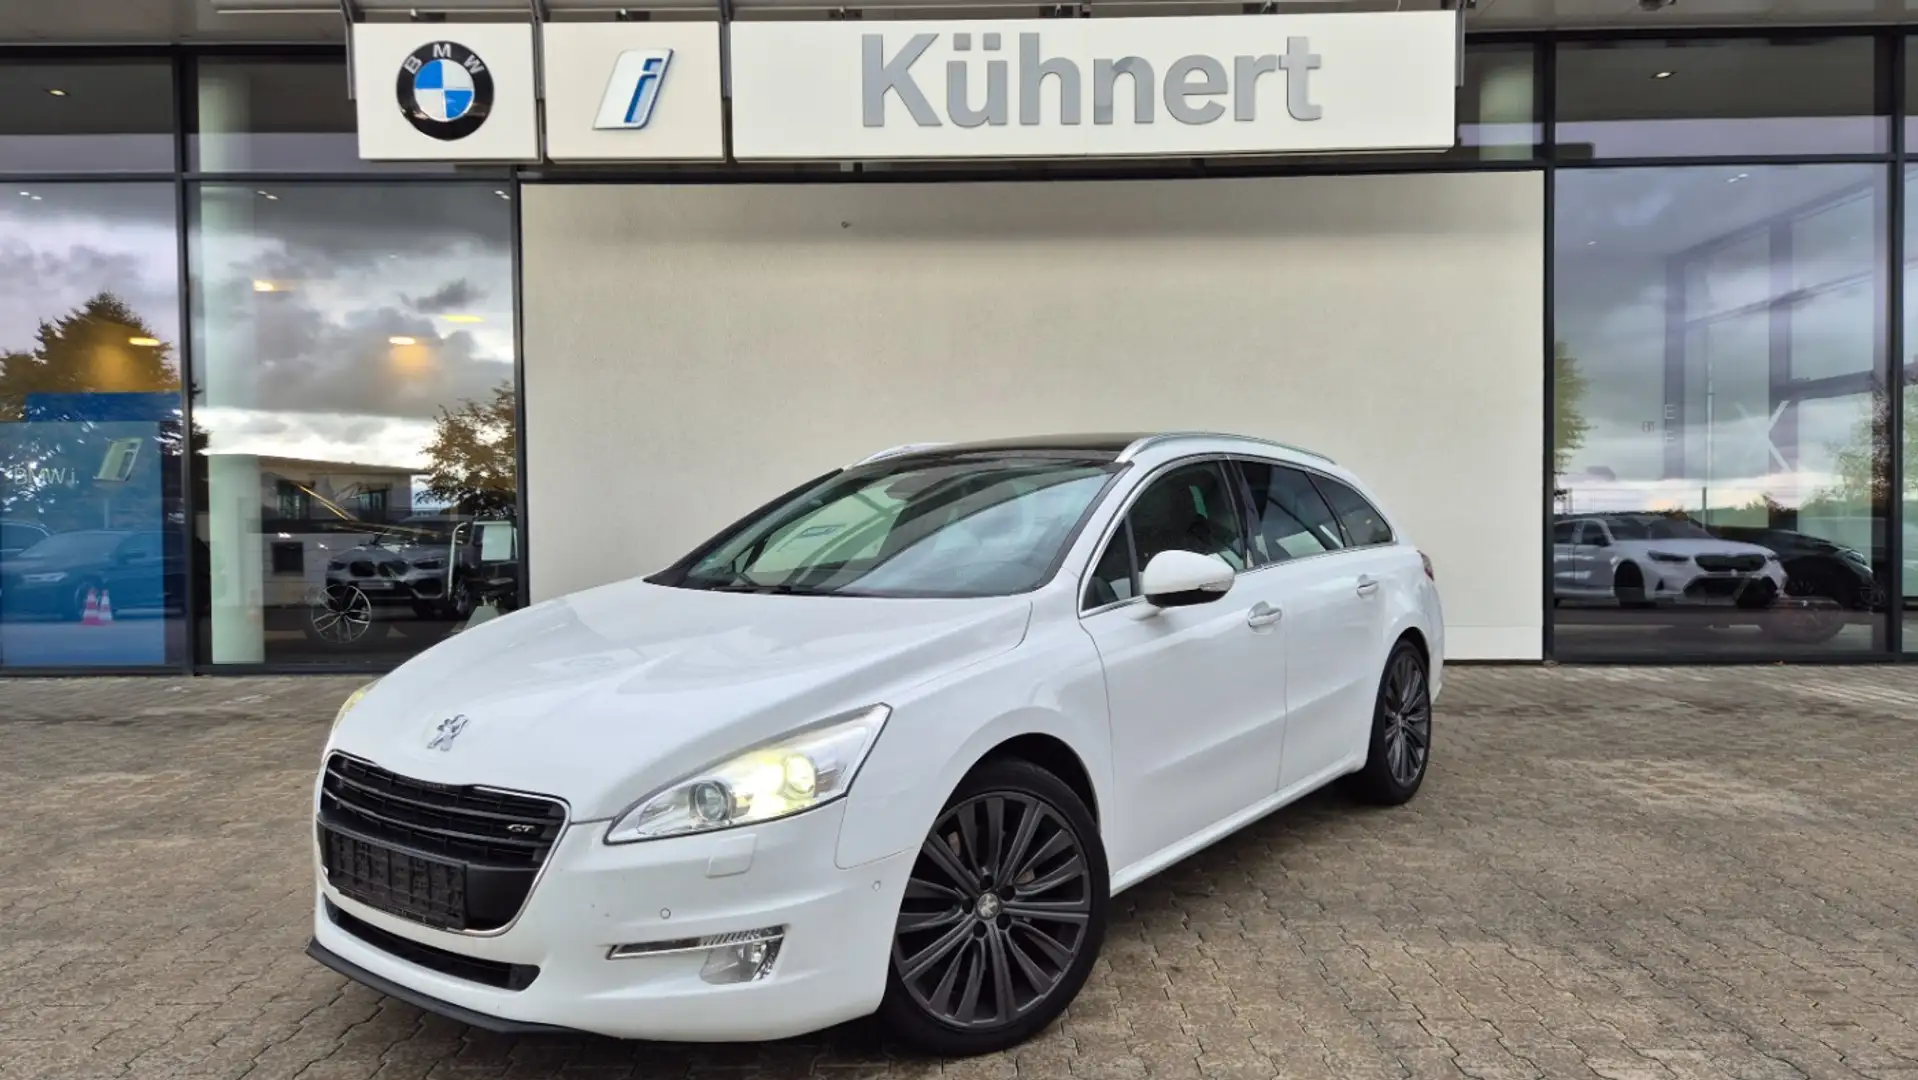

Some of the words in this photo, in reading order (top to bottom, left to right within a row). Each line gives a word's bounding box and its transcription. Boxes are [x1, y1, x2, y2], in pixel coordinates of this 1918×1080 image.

[403, 43, 486, 75] BMW
[861, 32, 1322, 128] Kühnert
[507, 824, 535, 833] GT
